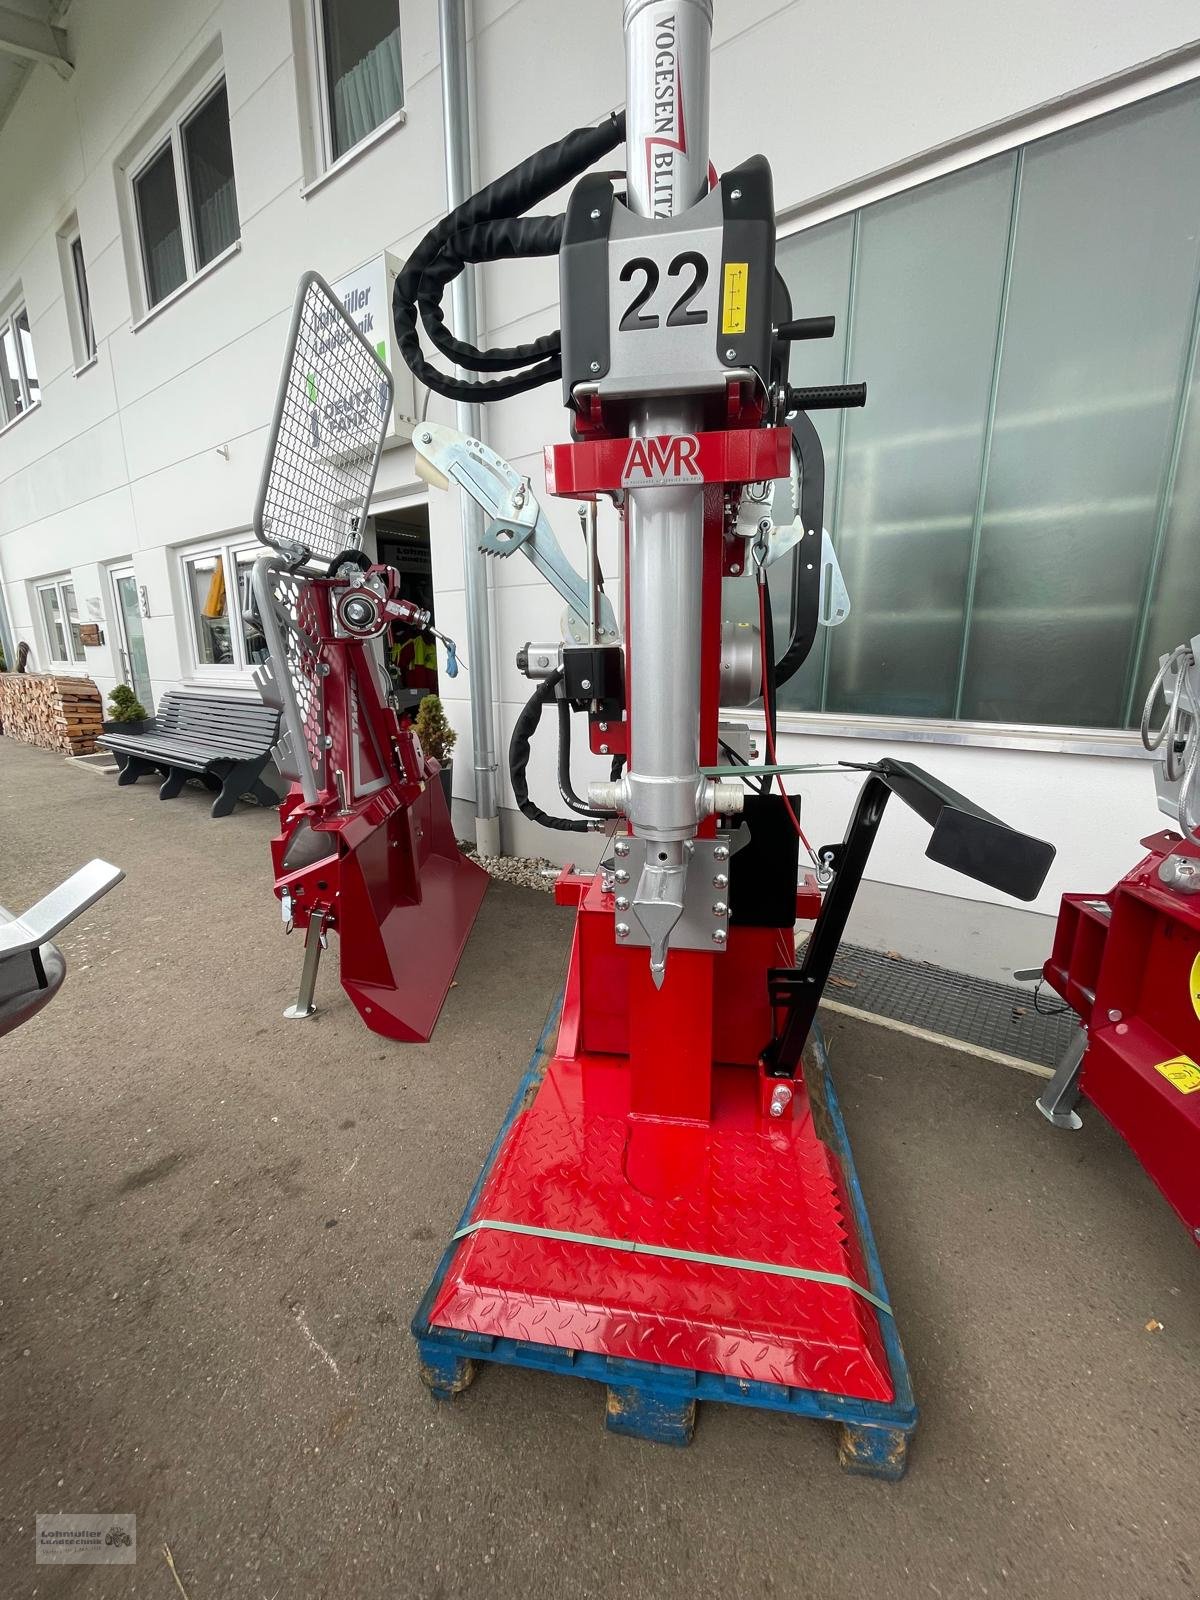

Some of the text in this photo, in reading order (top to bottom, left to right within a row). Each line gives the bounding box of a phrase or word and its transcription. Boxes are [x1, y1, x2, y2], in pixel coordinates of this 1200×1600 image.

[654, 15, 675, 134] VOGESEN
[618, 251, 709, 332] 22
[624, 436, 699, 479] AMR
